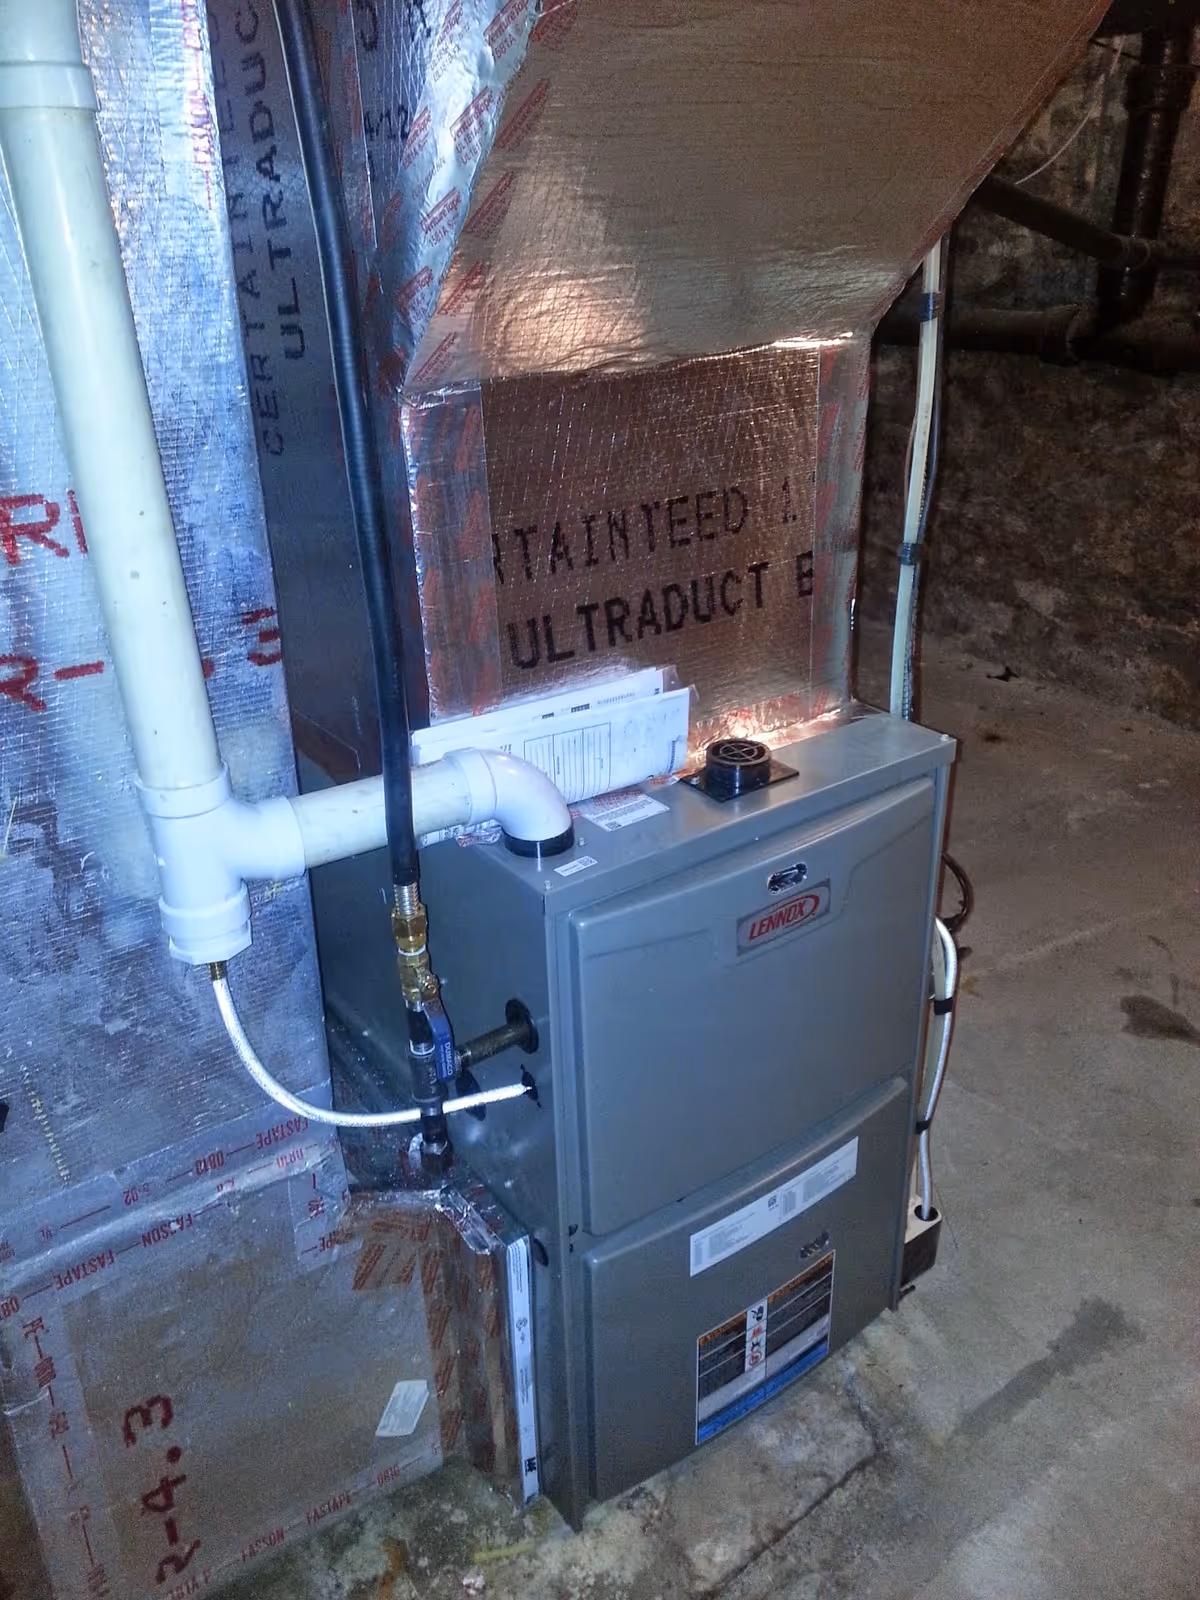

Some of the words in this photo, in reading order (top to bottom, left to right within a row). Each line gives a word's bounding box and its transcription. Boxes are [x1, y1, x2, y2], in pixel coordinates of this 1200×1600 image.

[506, 560, 770, 670] ULTRADUCT
[748, 899, 808, 942] LENNOX
[55, 1249, 116, 1291] FASTAPE
